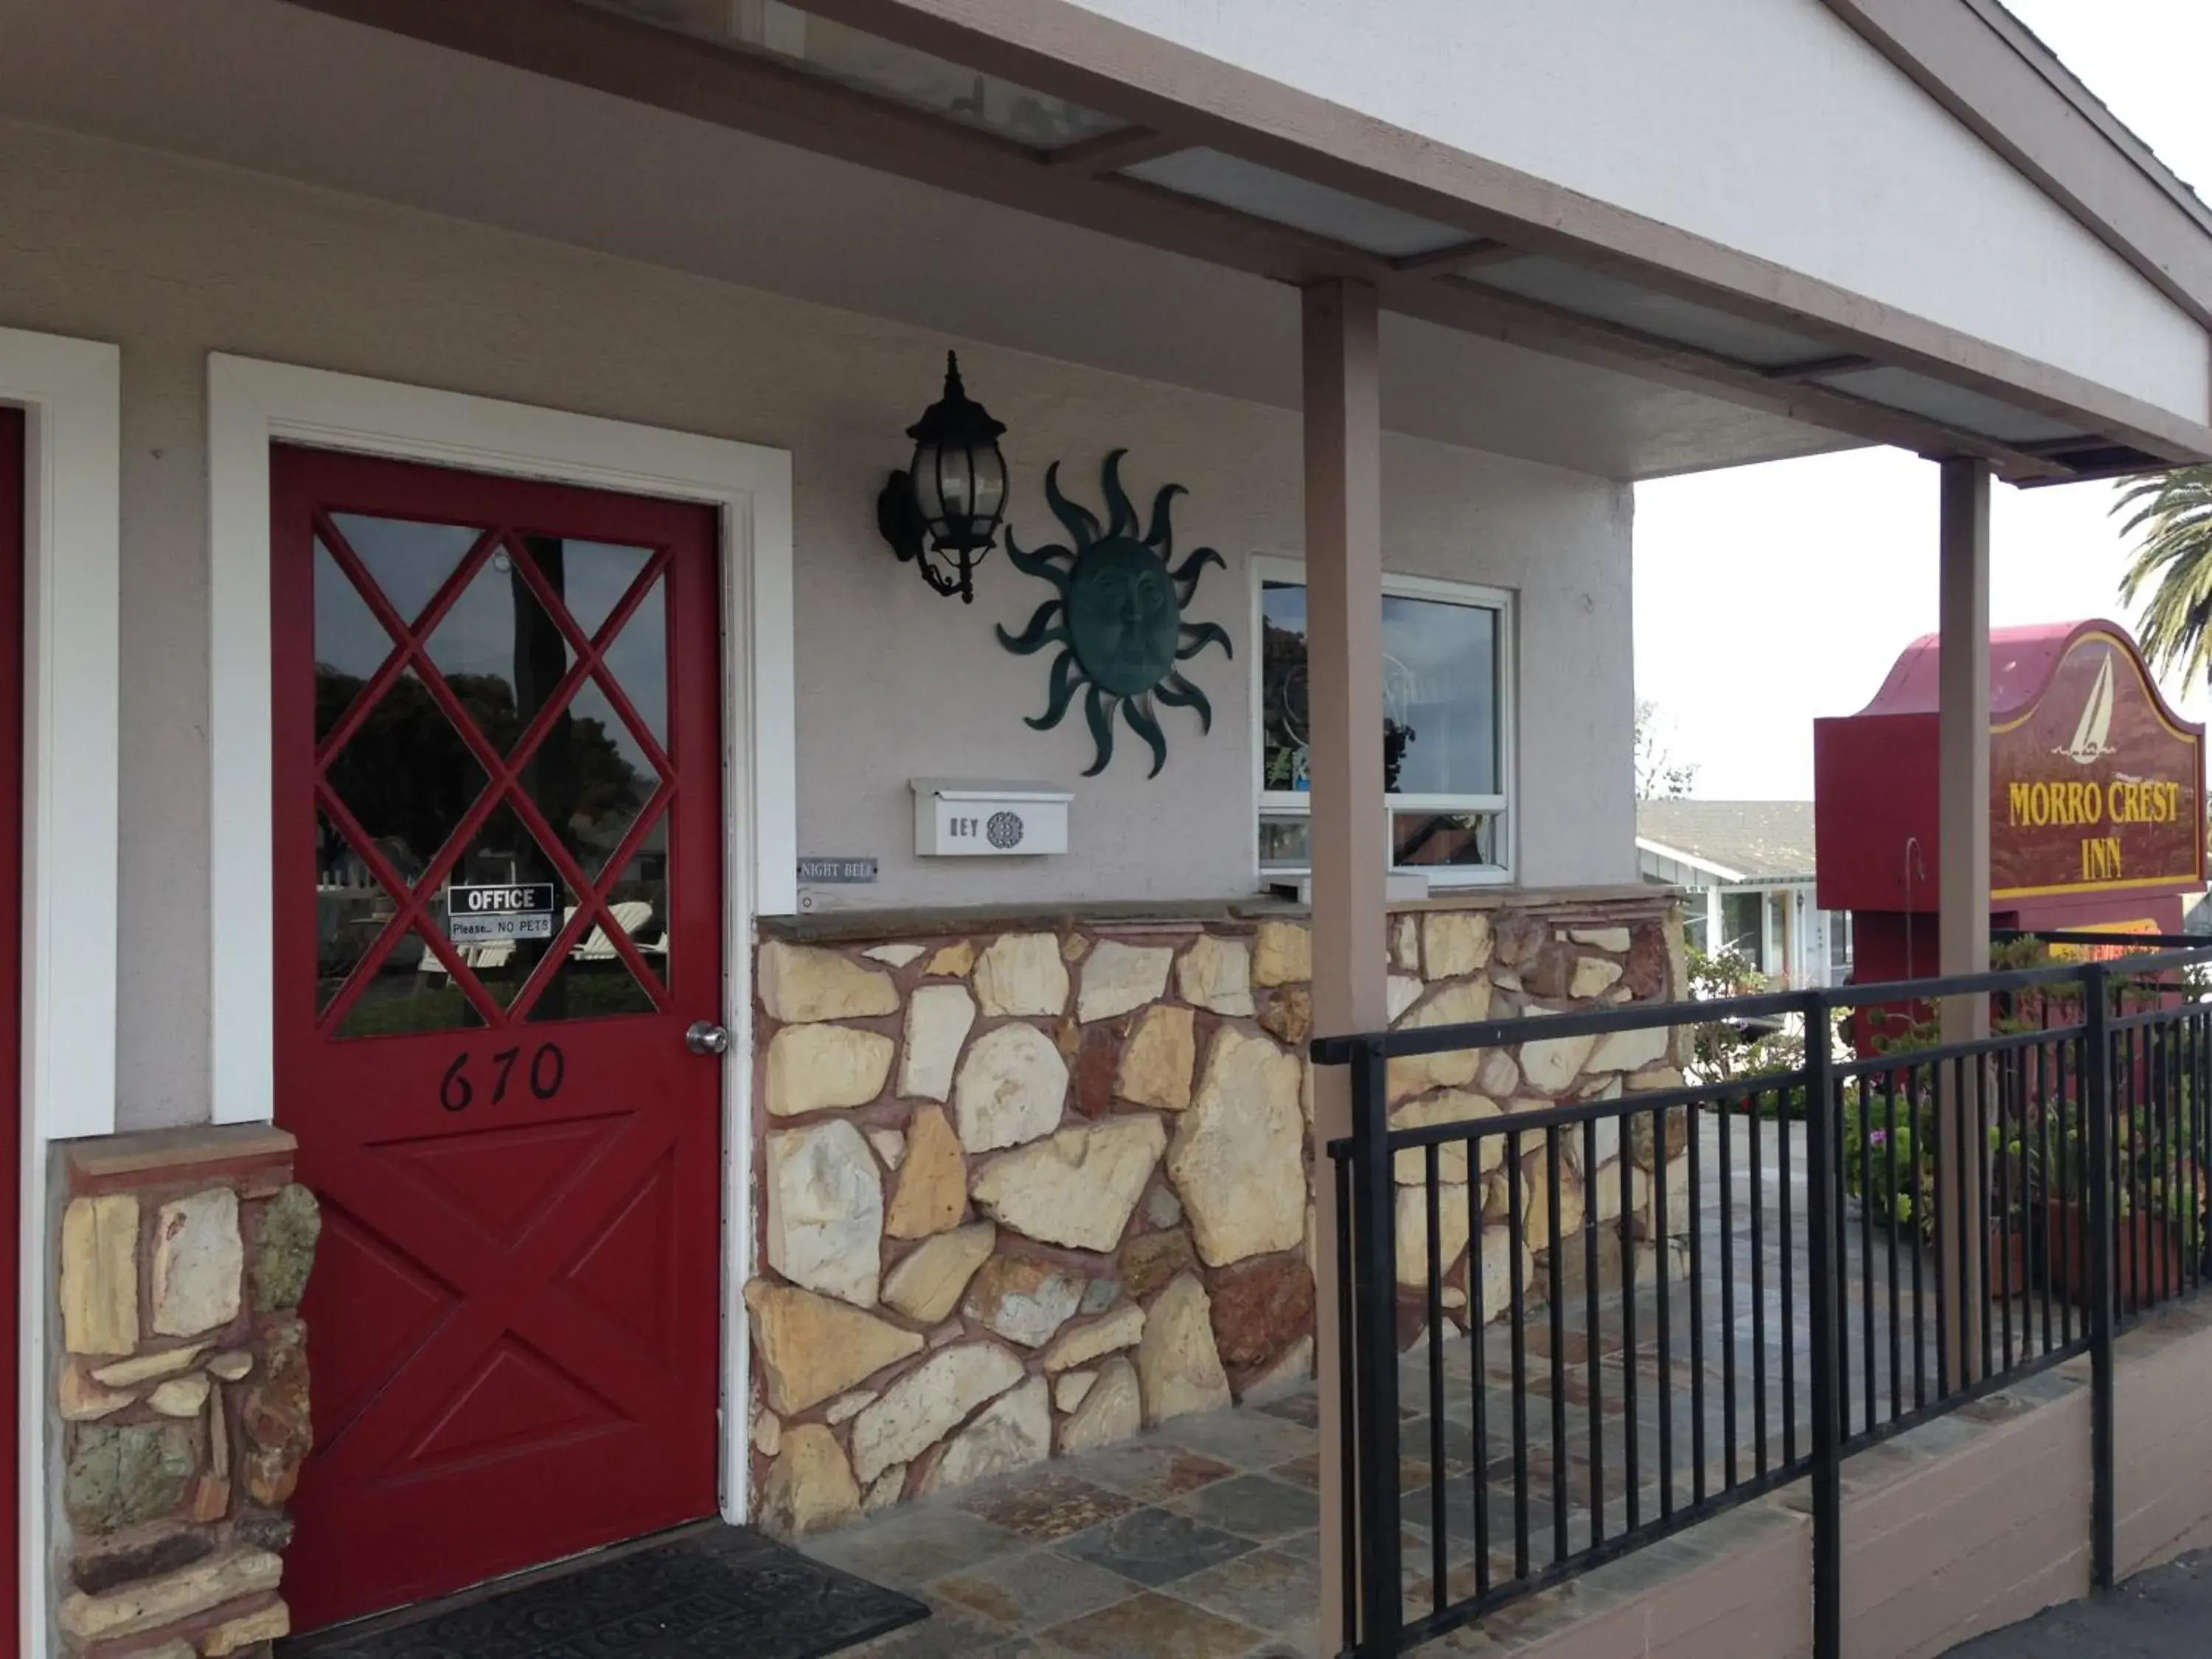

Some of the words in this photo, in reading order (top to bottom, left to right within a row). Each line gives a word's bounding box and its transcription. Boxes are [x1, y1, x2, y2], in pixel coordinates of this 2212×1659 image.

[2009, 781, 2102, 827] MORRO
[2108, 780, 2180, 823] CREST
[801, 862, 840, 877] NIGHT
[844, 862, 873, 877] BELL
[2081, 837, 2122, 880] INN
[468, 889, 535, 911] OFFICE
[498, 921, 514, 933] NO
[520, 919, 549, 931] PETS
[439, 1041, 563, 1112] 670
